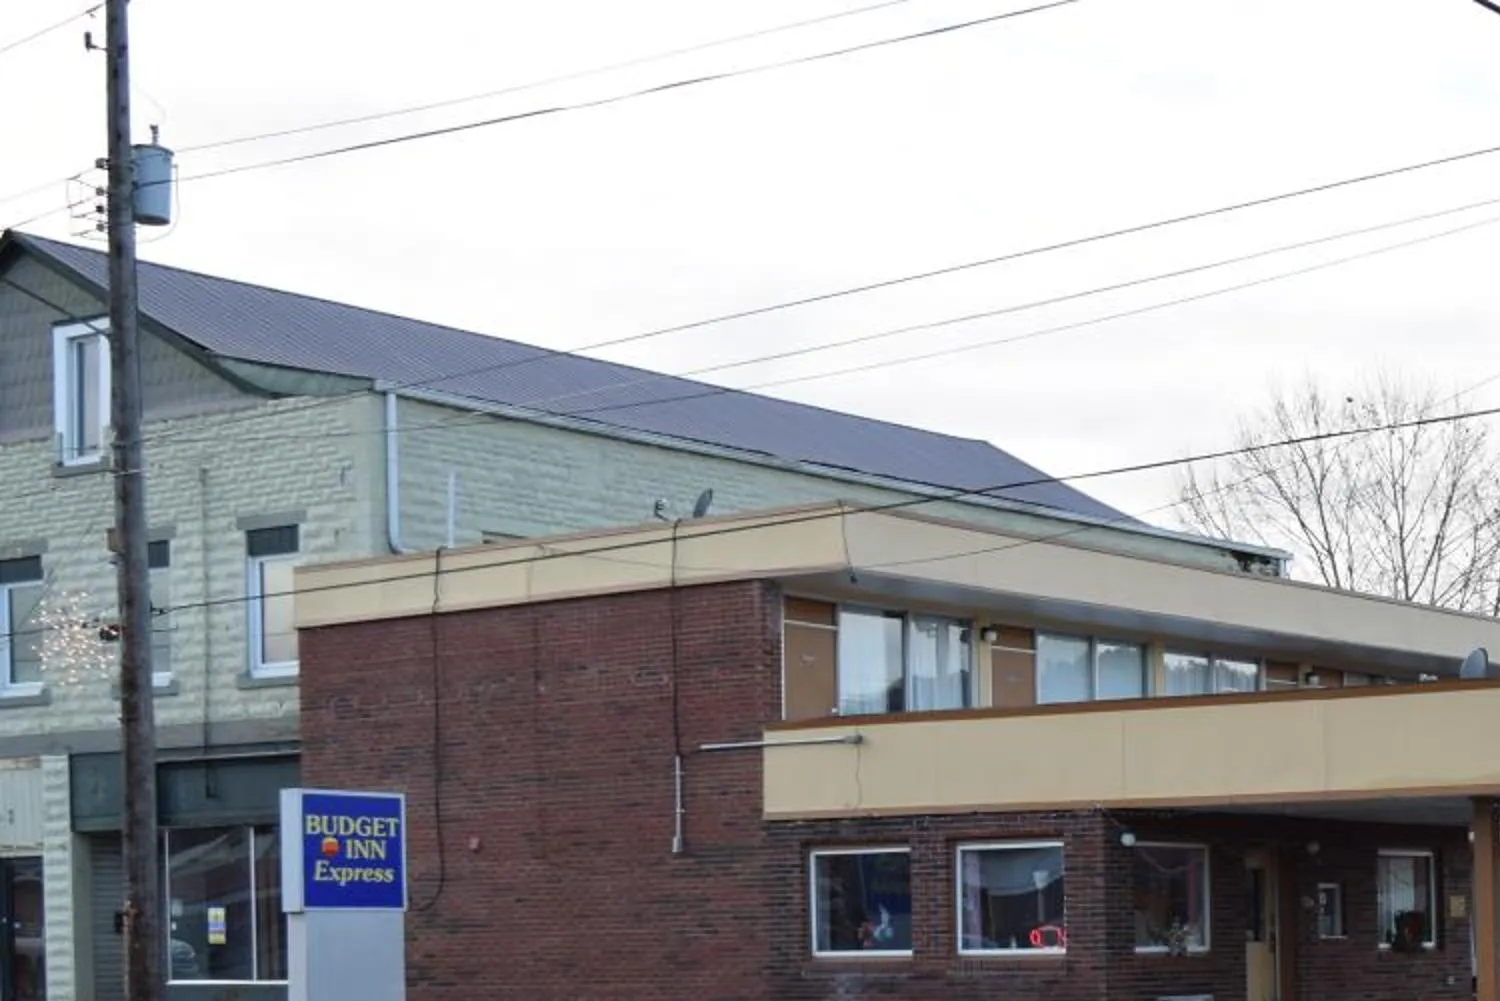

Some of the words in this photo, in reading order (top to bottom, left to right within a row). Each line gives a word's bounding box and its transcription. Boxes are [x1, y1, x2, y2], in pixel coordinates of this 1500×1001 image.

[305, 814, 399, 838] BUDGET
[345, 839, 387, 860] INN
[313, 860, 395, 887] Express
